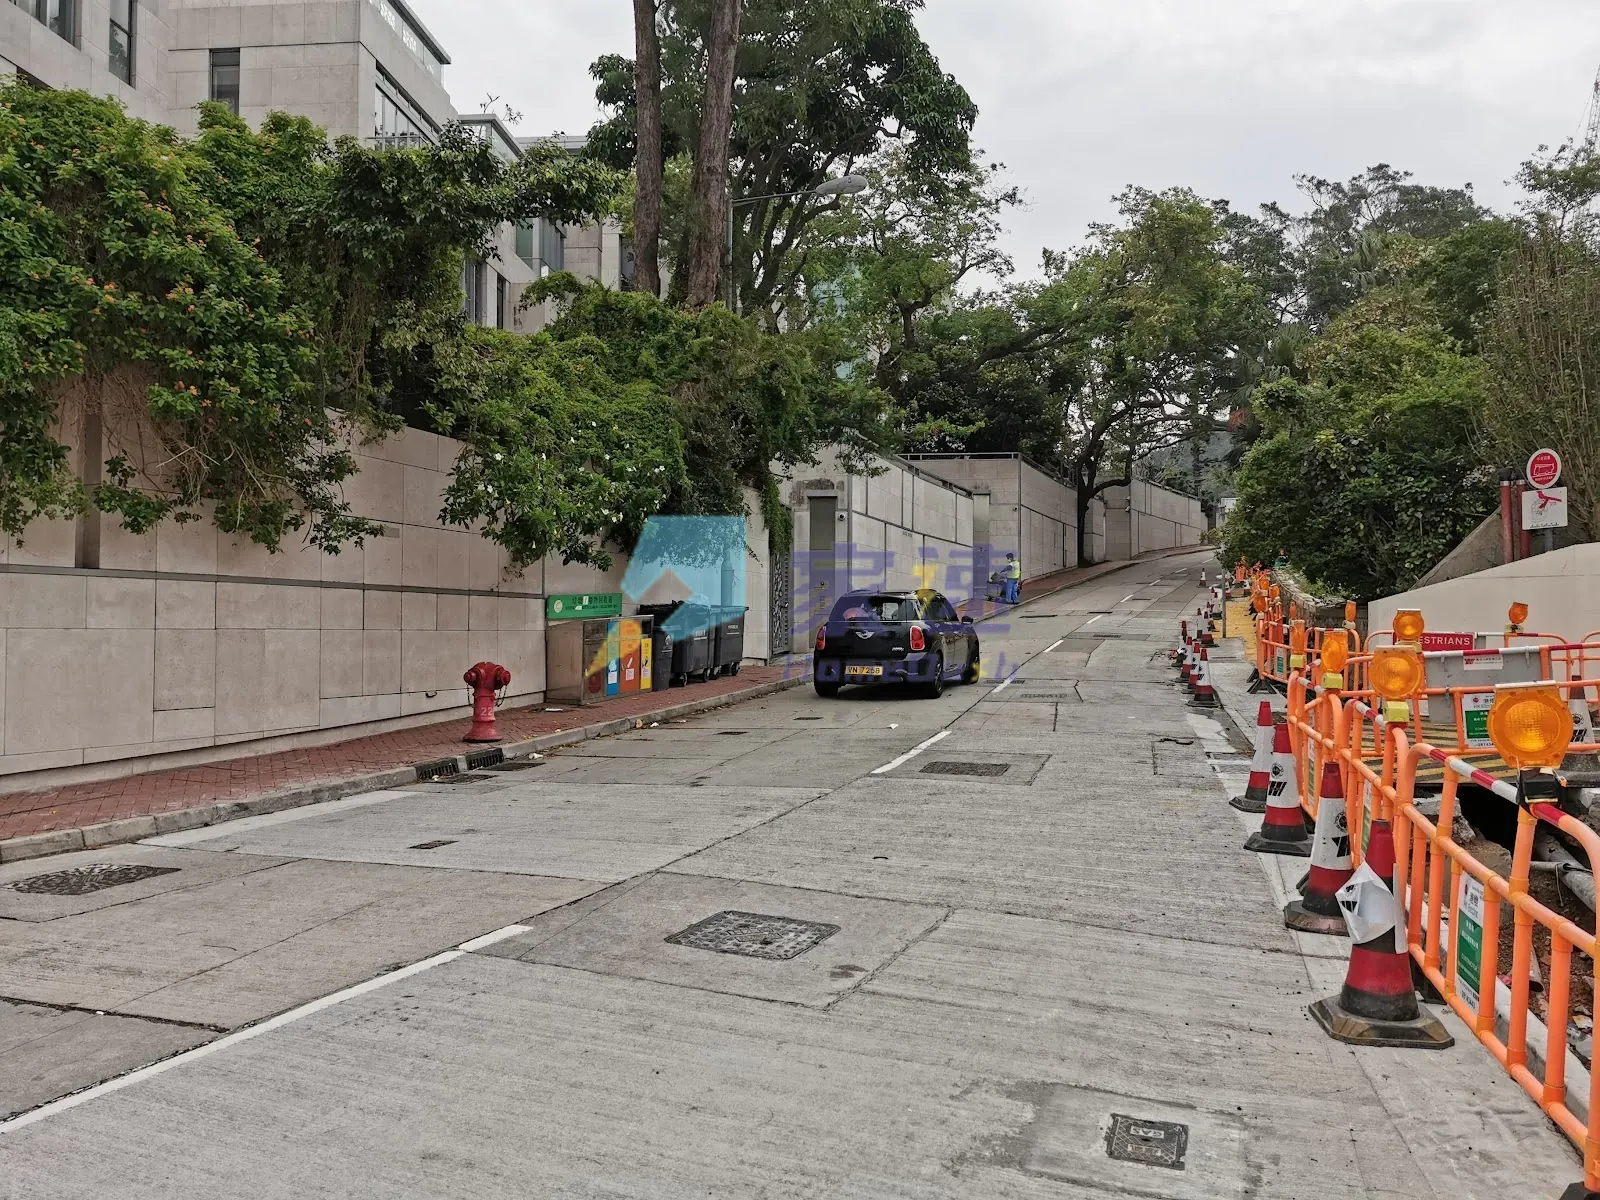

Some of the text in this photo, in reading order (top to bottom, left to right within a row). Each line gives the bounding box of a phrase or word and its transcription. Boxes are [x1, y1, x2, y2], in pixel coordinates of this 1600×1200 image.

[1418, 636, 1470, 645] ESTRIANS
[480, 706, 493, 716] 22
[1132, 1127, 1163, 1137] GAS
